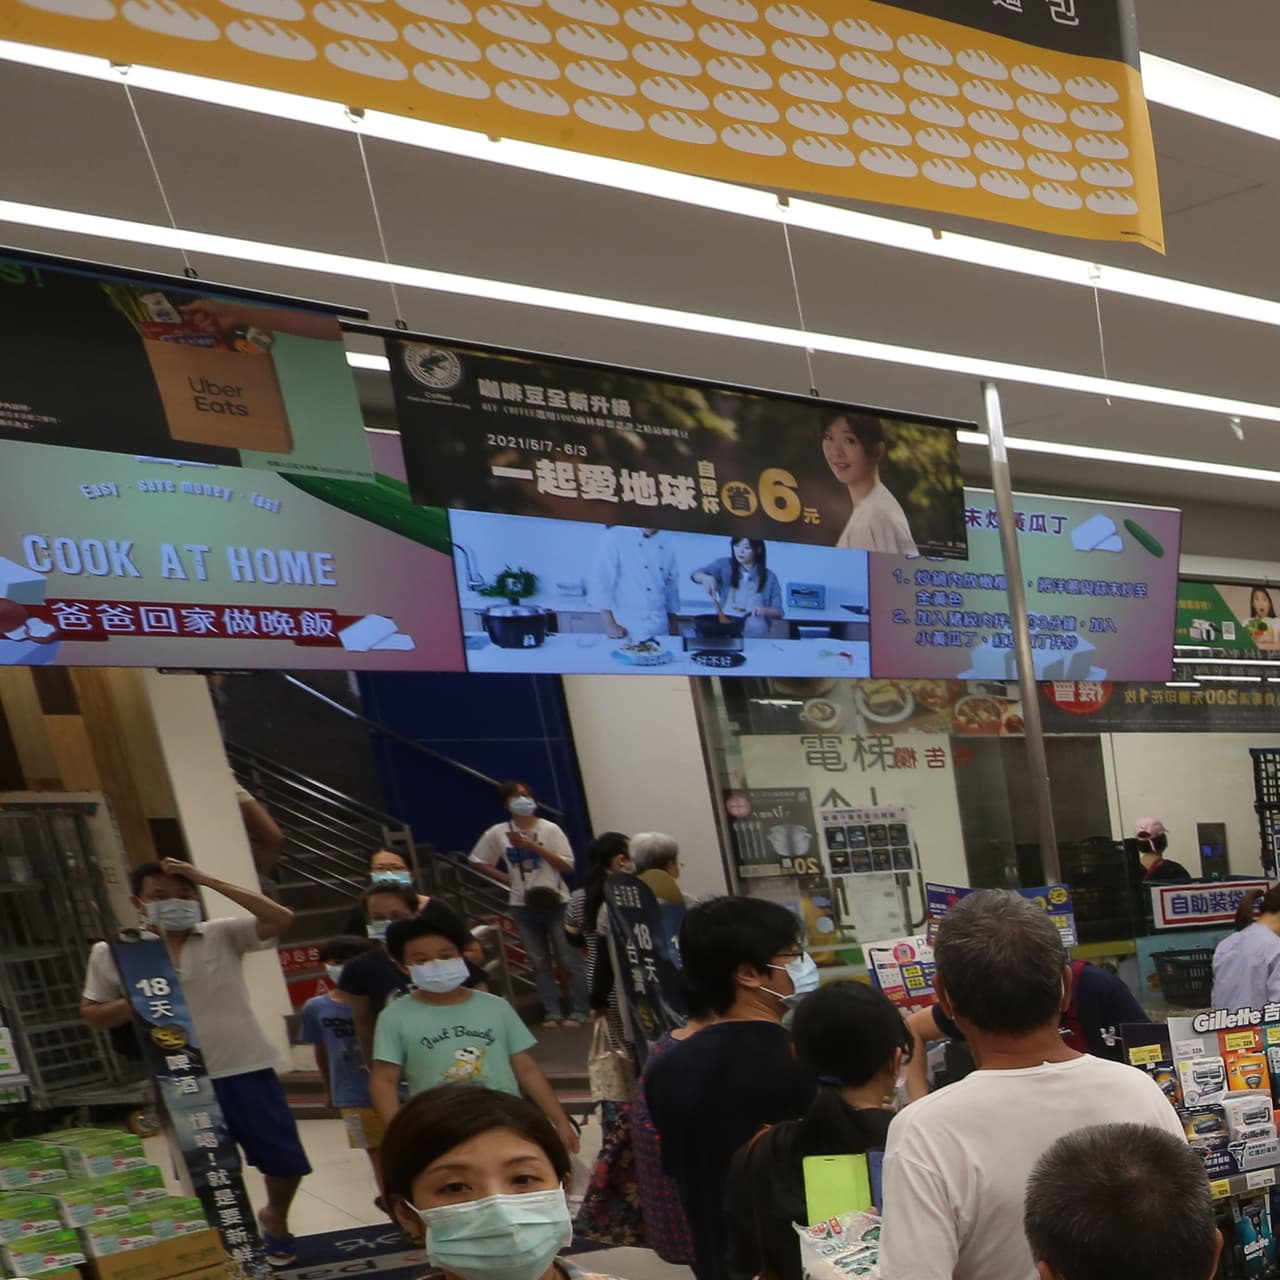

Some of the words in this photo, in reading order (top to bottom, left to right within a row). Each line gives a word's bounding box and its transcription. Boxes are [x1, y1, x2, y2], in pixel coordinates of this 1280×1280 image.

[187, 375, 244, 398] Uber
[478, 378, 632, 418] 咖啡豆全新升級
[193, 395, 249, 418] Eats
[80, 481, 121, 500] Easy
[137, 478, 176, 495] save
[180, 480, 234, 502] money
[491, 458, 698, 511] 一起愛地球
[22, 534, 142, 579] COOK
[160, 543, 210, 582] AT
[227, 545, 338, 587] HOME
[51, 602, 338, 639] 爸爸回家做晚飯
[801, 734, 896, 772] 電梯
[1171, 889, 1264, 914] 自助裝袋
[1193, 1007, 1262, 1033] Gillette
[420, 1028, 450, 1050] Just
[452, 1025, 497, 1047] Beachy
